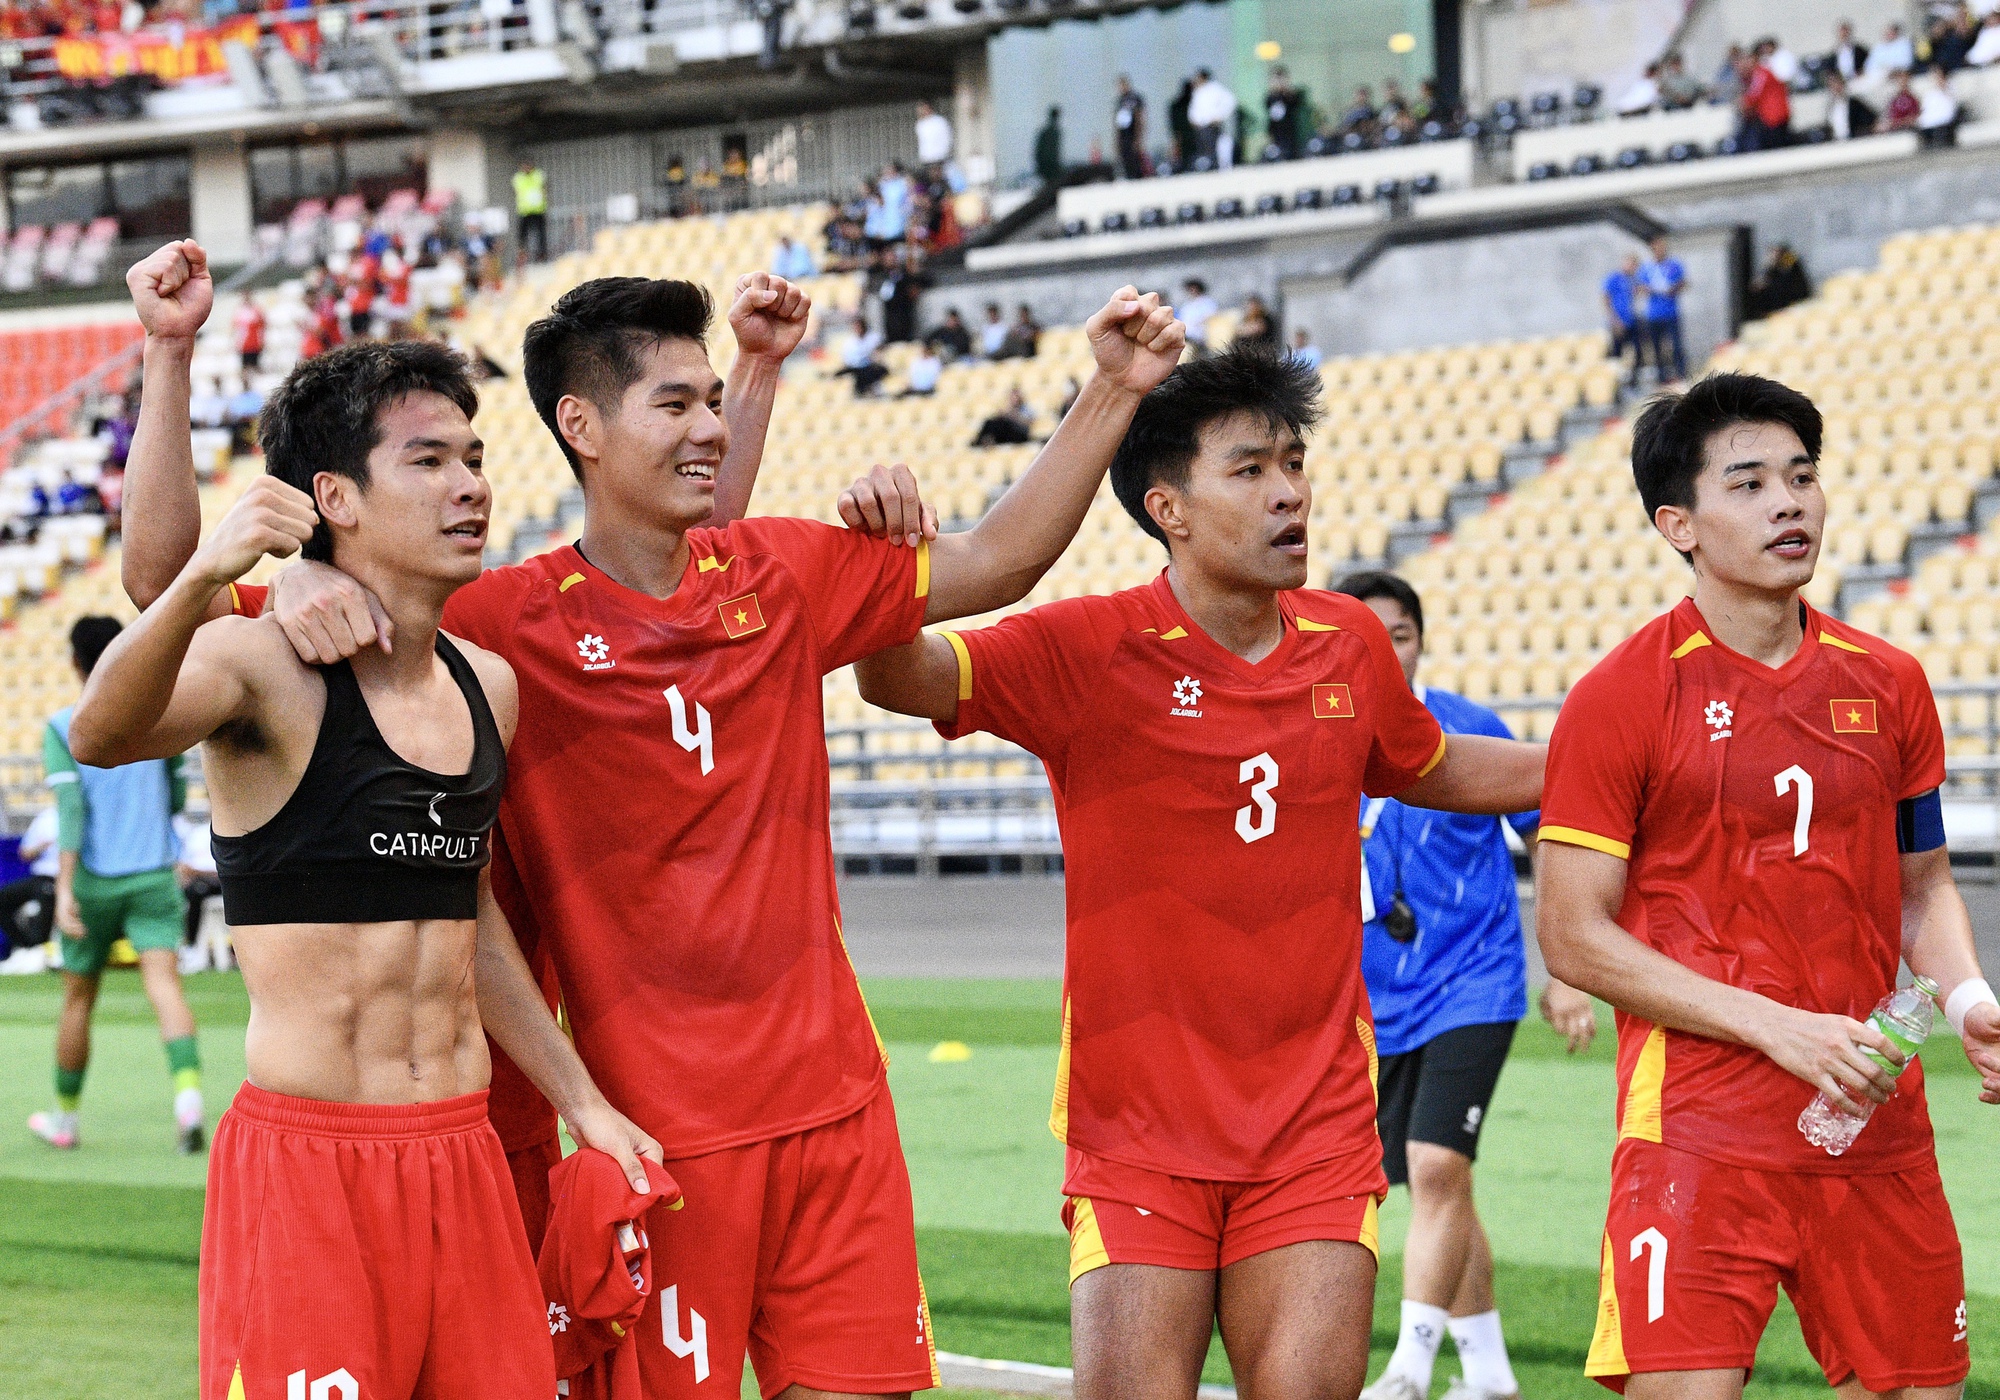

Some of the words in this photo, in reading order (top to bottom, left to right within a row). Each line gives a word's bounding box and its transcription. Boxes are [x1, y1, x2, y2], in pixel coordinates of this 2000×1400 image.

[663, 684, 715, 776] 4
[1235, 752, 1279, 844] 3
[1774, 765, 1814, 857] 7
[369, 832, 480, 859] CATAPULT
[1630, 1227, 1668, 1324] 7
[661, 1285, 709, 1384] 4
